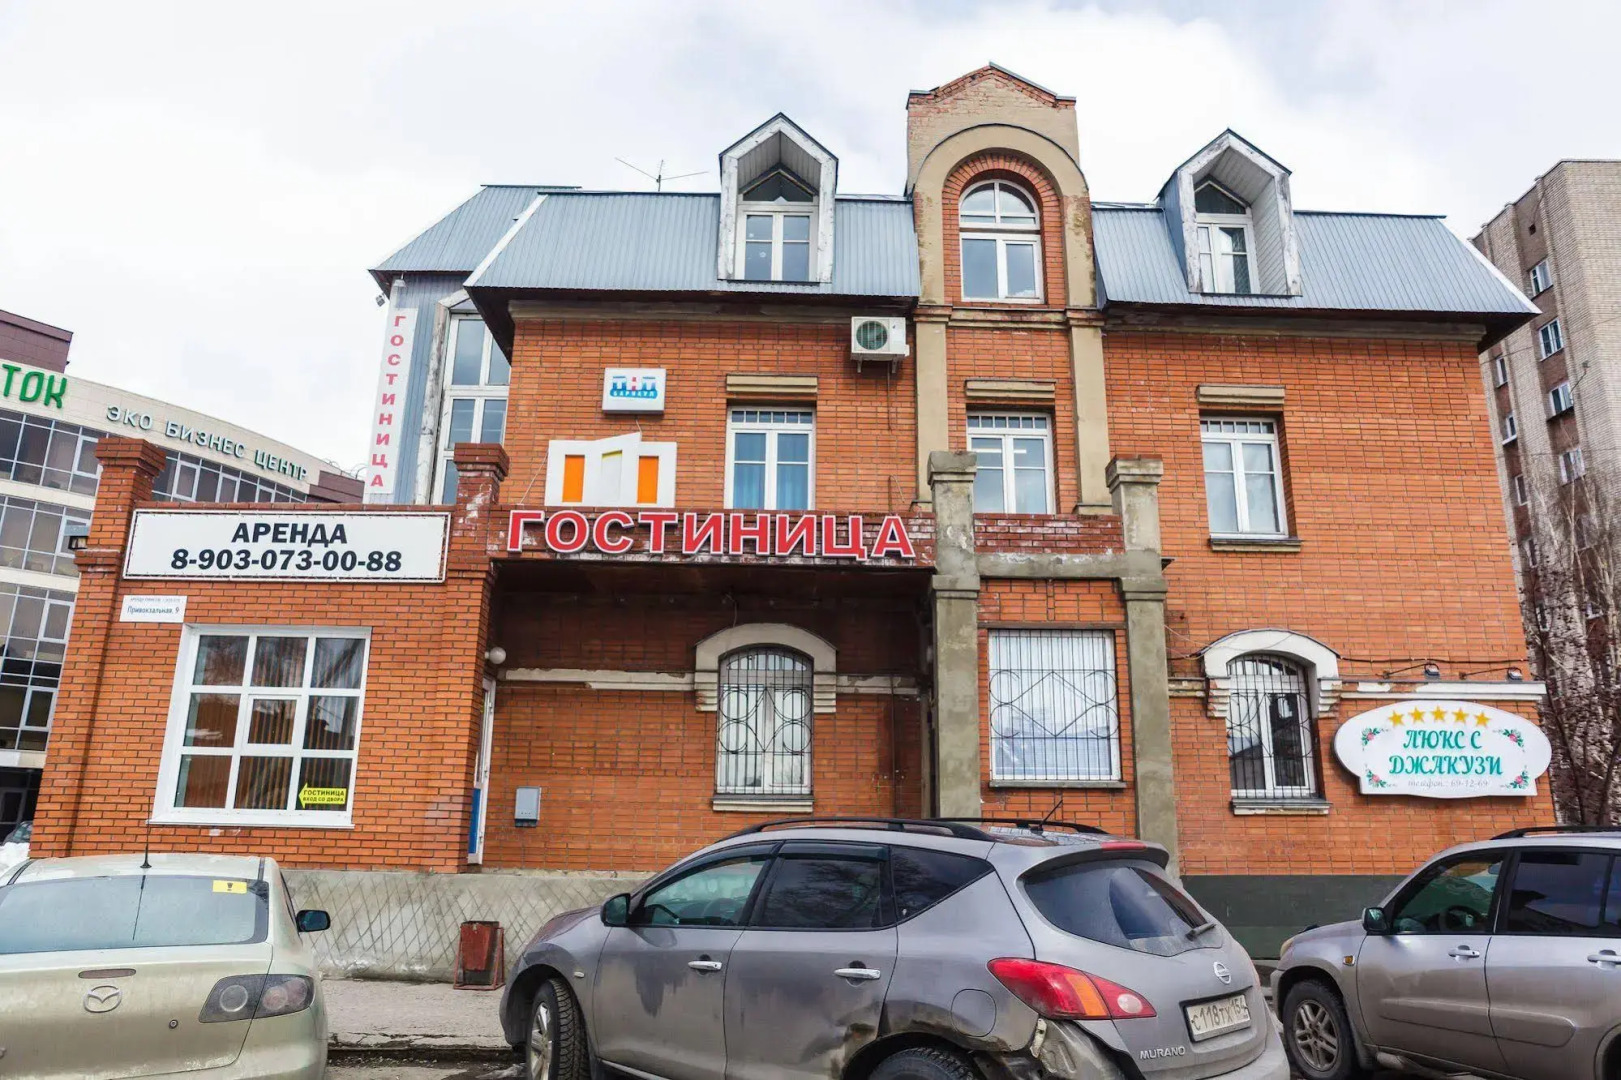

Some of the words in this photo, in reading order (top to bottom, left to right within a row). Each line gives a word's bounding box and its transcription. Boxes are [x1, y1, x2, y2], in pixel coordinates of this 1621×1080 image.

[370, 315, 407, 488] ГОСТИНИЦА
[107, 405, 153, 431] ЭКО
[165, 420, 246, 459] БИЗНЕС
[254, 449, 310, 481] ЦЕНТР
[231, 522, 348, 548] АРЕНДА
[506, 509, 917, 562] ГОСТИНИЦА
[170, 548, 402, 572] 8-903-073-00-88
[1403, 730, 1466, 750] ЛЮКС
[1470, 730, 1482, 750] С
[1388, 755, 1503, 775] ДЖАКУЗИ
[1139, 1046, 1186, 1060] MURANO
